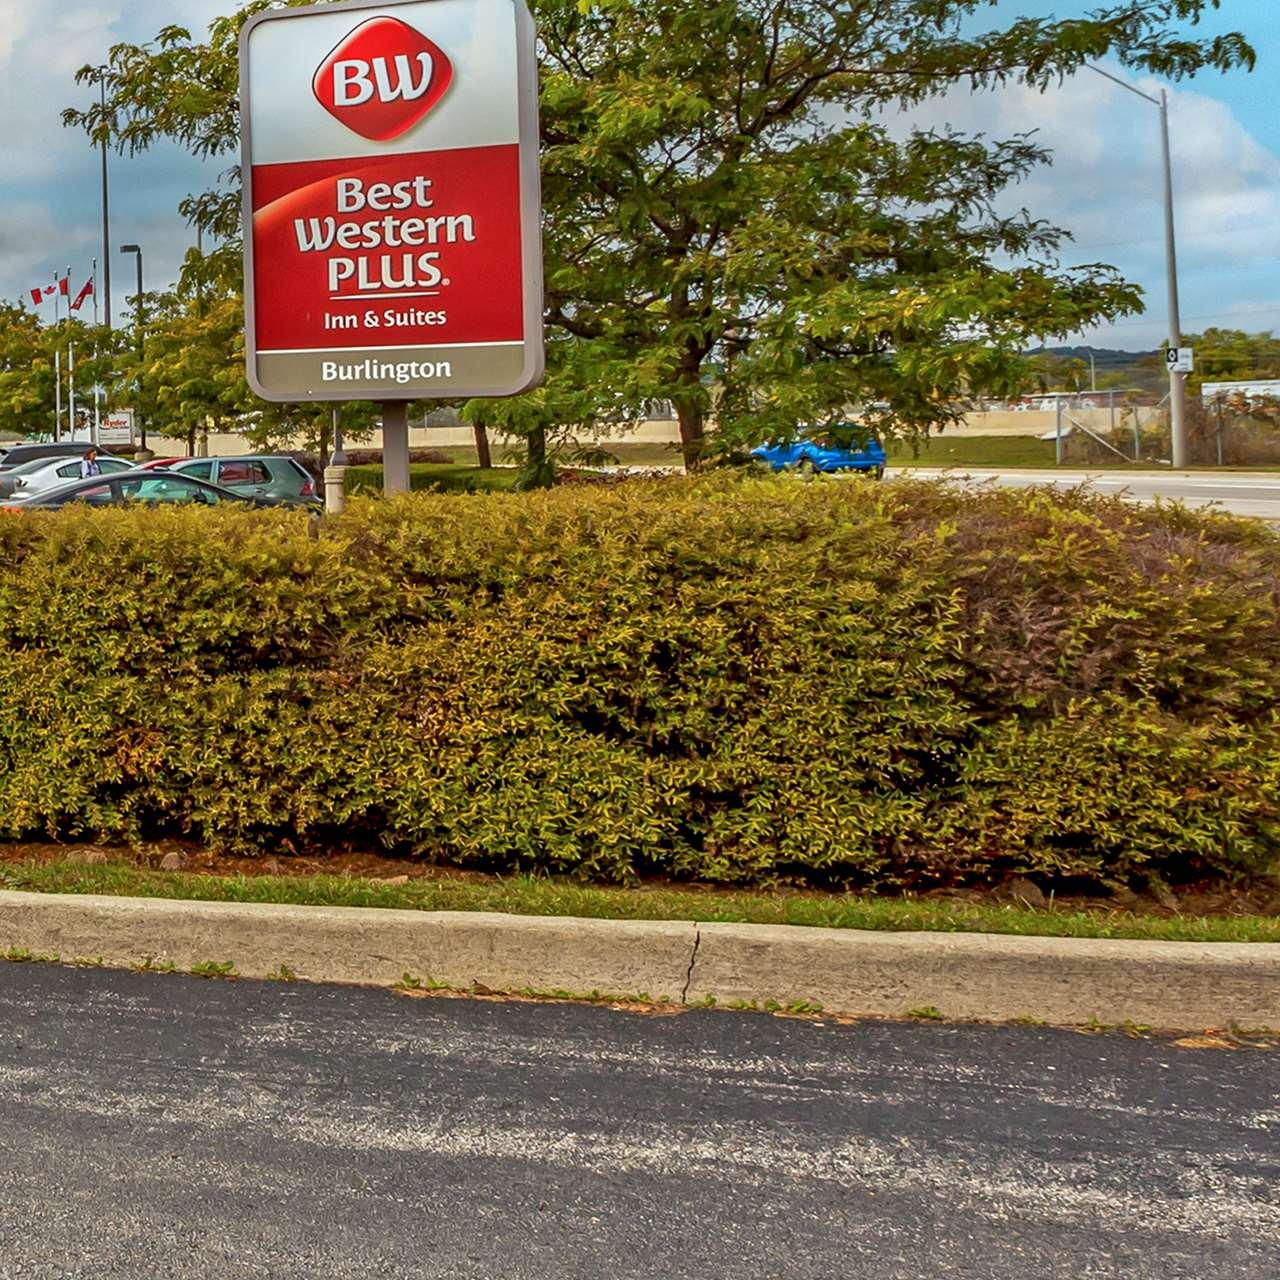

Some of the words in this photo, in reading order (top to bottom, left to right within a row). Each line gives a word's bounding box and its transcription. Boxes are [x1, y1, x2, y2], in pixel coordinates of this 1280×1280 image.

[333, 51, 433, 107] BW
[336, 175, 433, 213] Best
[294, 214, 475, 253] Western
[324, 312, 358, 329] Inn
[364, 310, 380, 328] &
[383, 308, 447, 327] Suites
[322, 359, 451, 384] Burlington
